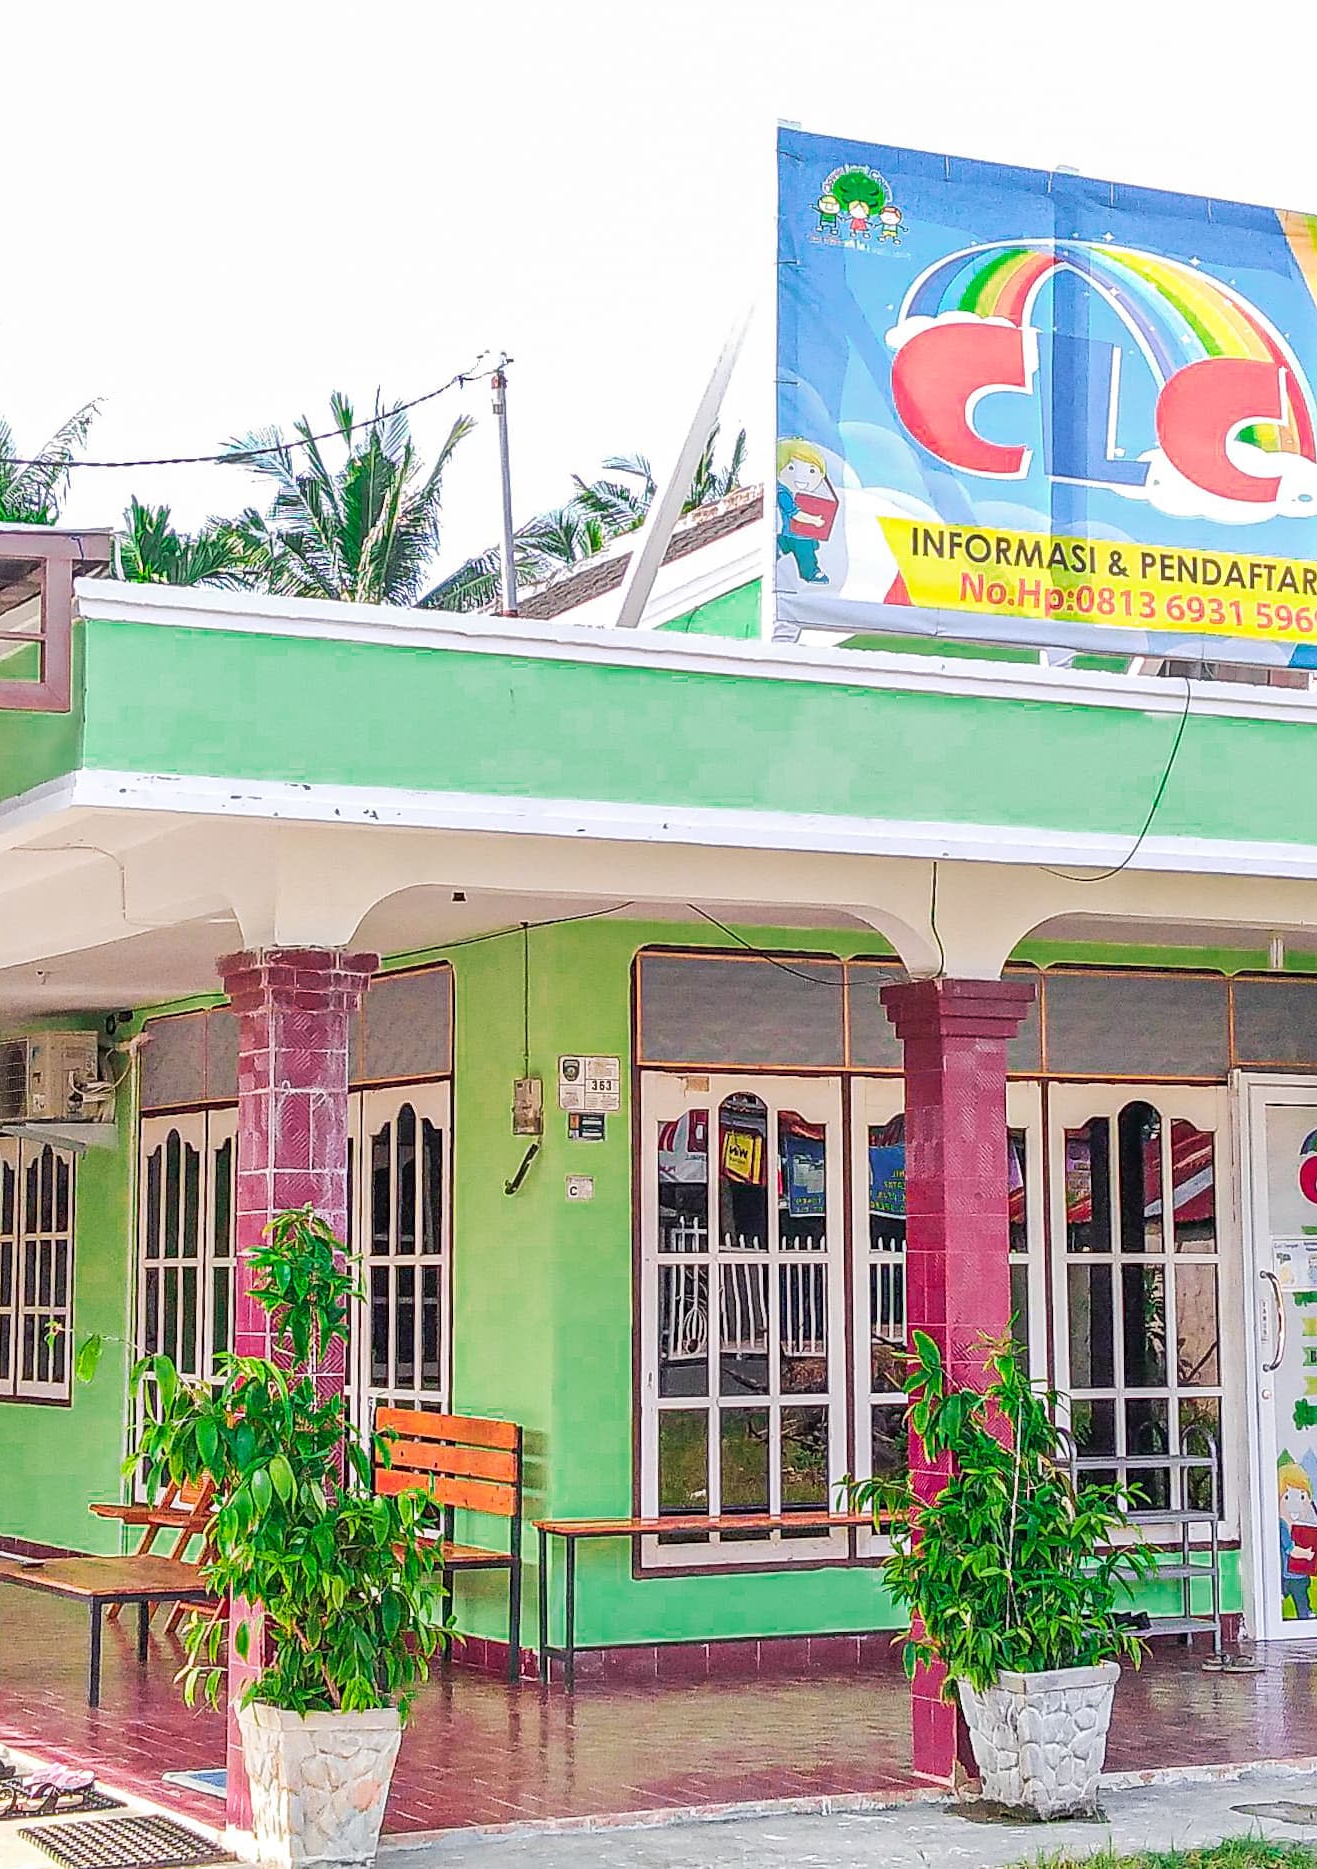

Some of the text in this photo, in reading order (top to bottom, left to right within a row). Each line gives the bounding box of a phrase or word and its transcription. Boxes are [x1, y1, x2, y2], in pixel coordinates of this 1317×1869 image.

[891, 320, 1289, 503] CLC
[912, 527, 1096, 574] INFORMASI
[1108, 552, 1129, 578] &
[1167, 593, 1243, 627] 6931
